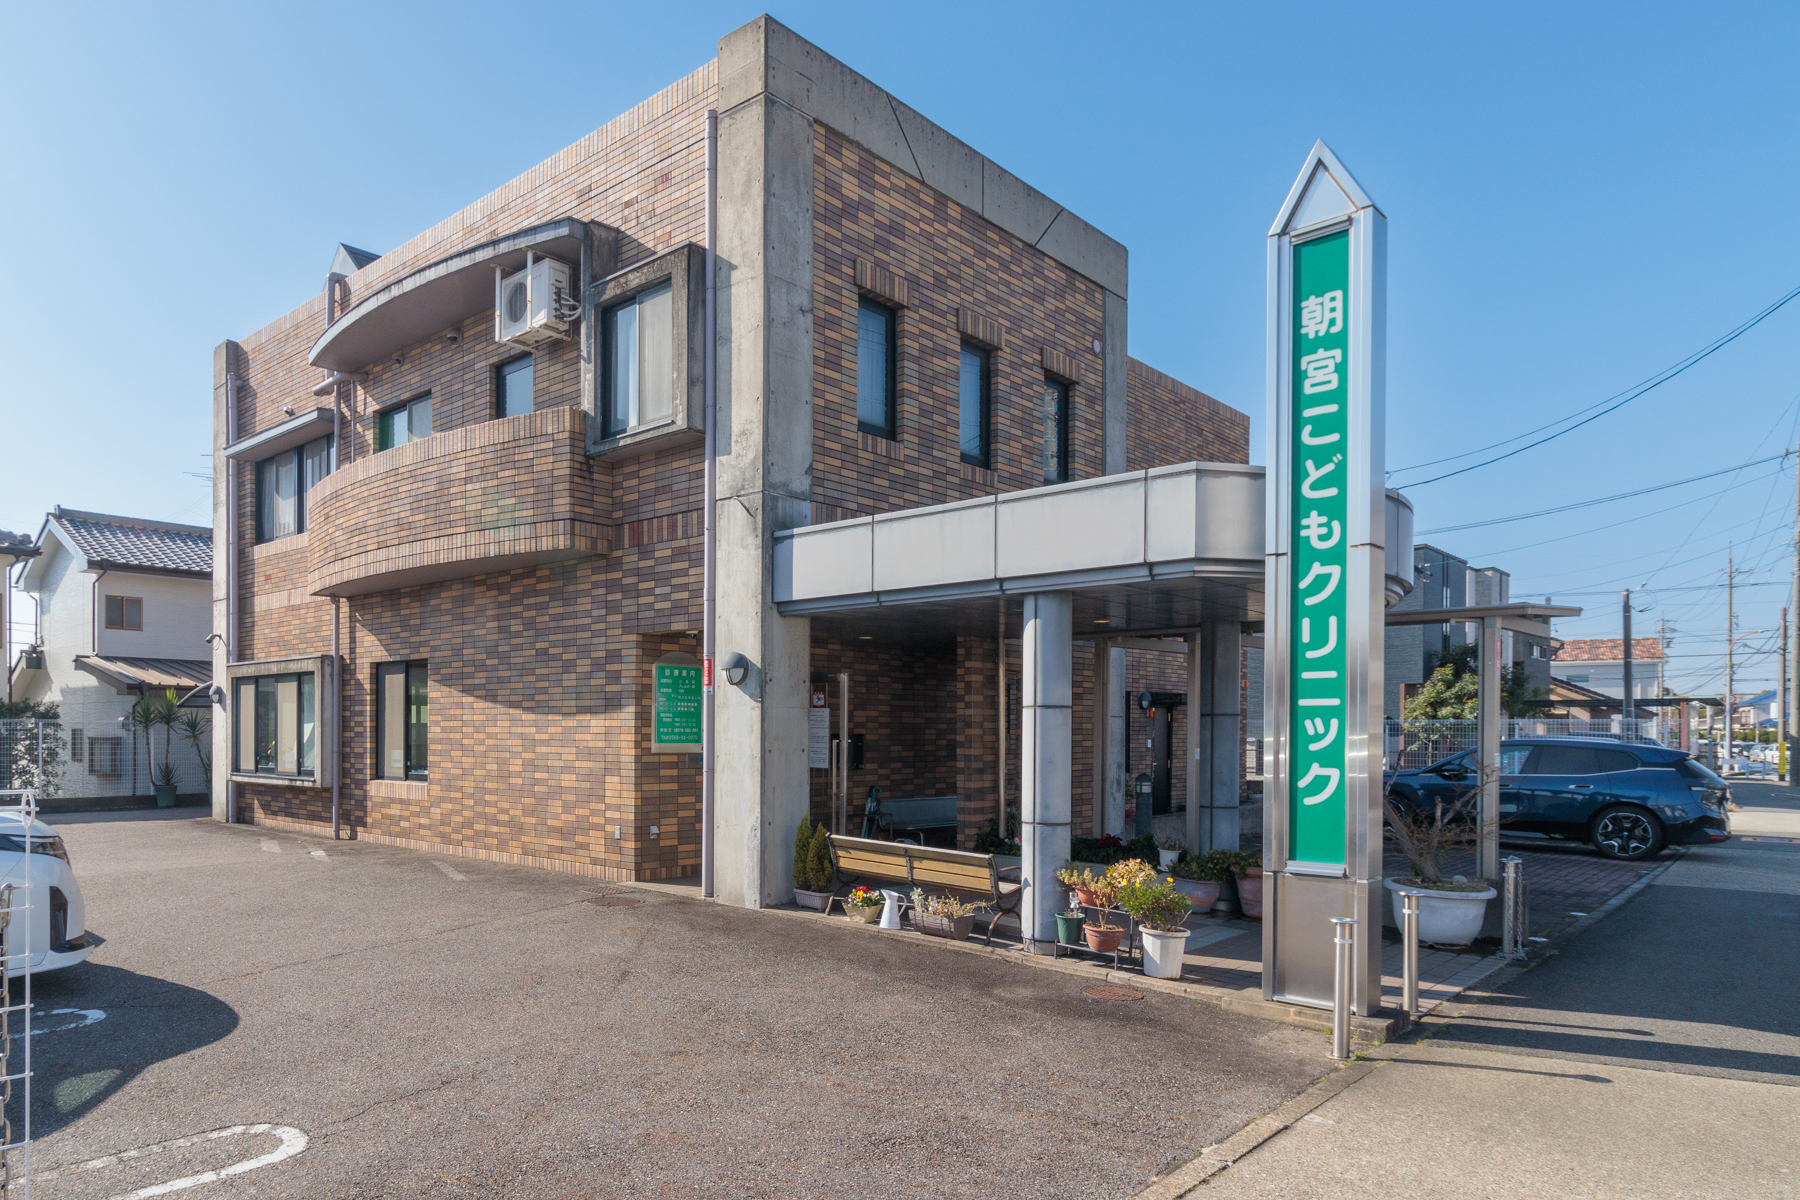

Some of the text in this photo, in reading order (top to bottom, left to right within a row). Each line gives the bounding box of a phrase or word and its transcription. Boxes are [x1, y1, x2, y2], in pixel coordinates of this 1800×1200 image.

[1297, 289, 1344, 806] 朝宮こどもクリニック
